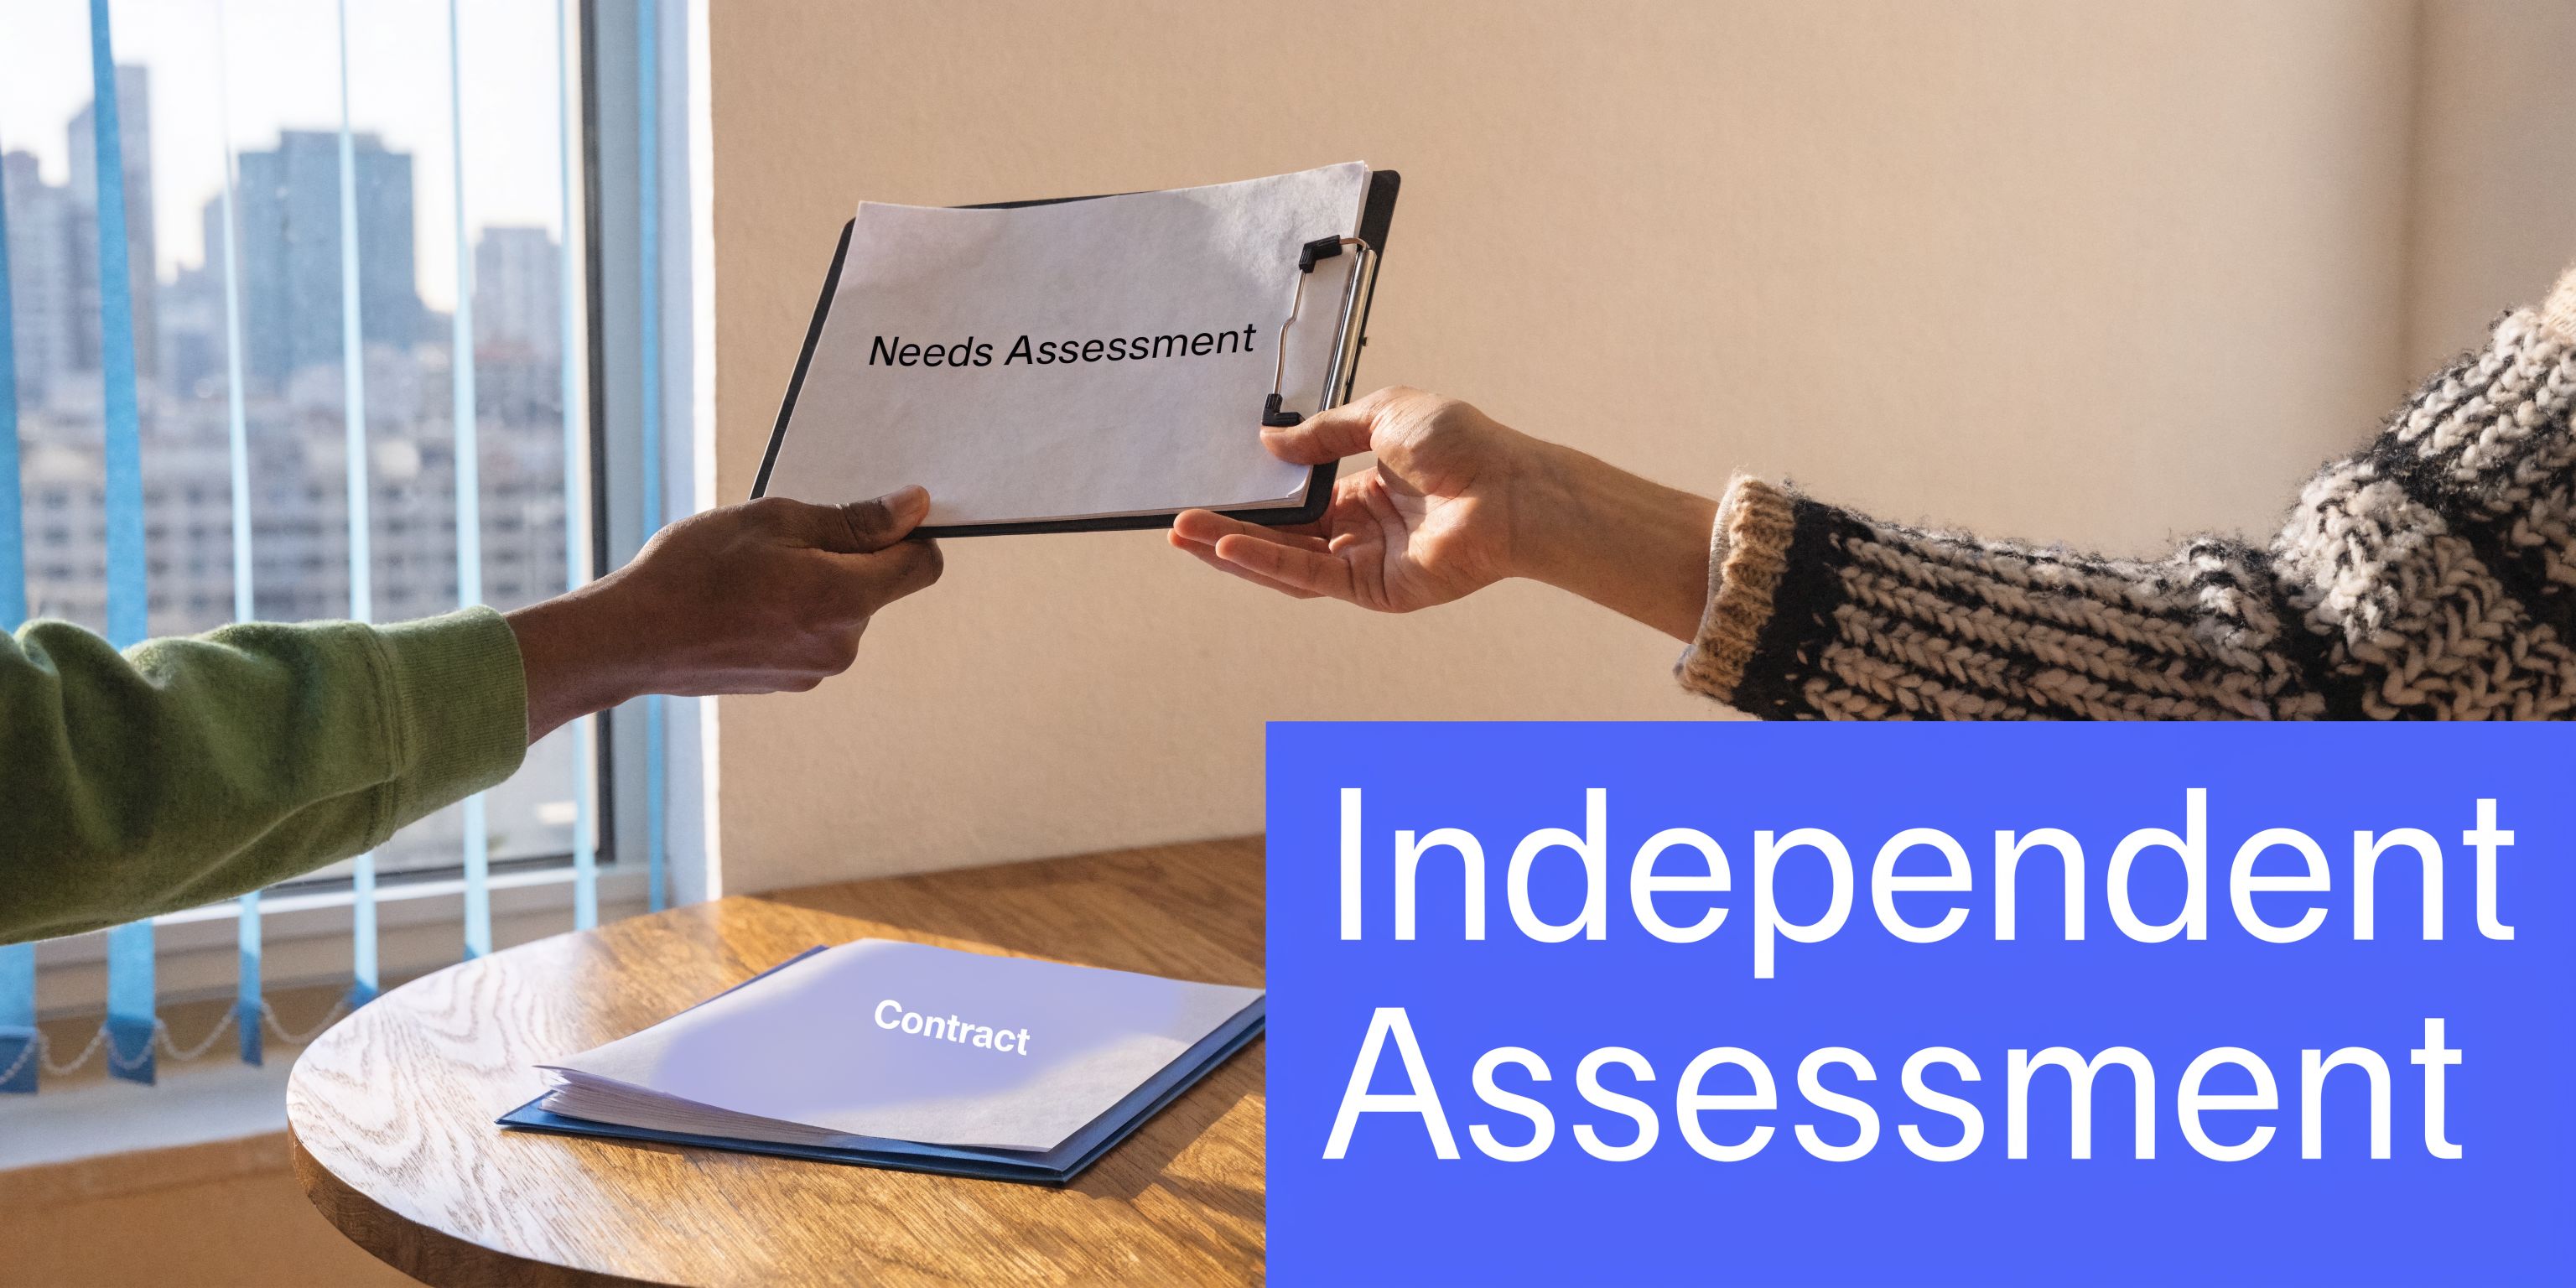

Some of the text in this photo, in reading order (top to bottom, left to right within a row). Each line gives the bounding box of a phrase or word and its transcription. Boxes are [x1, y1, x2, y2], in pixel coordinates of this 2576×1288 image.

[869, 323, 1257, 367] Needs Assessment
[874, 999, 1031, 1056] Contract
